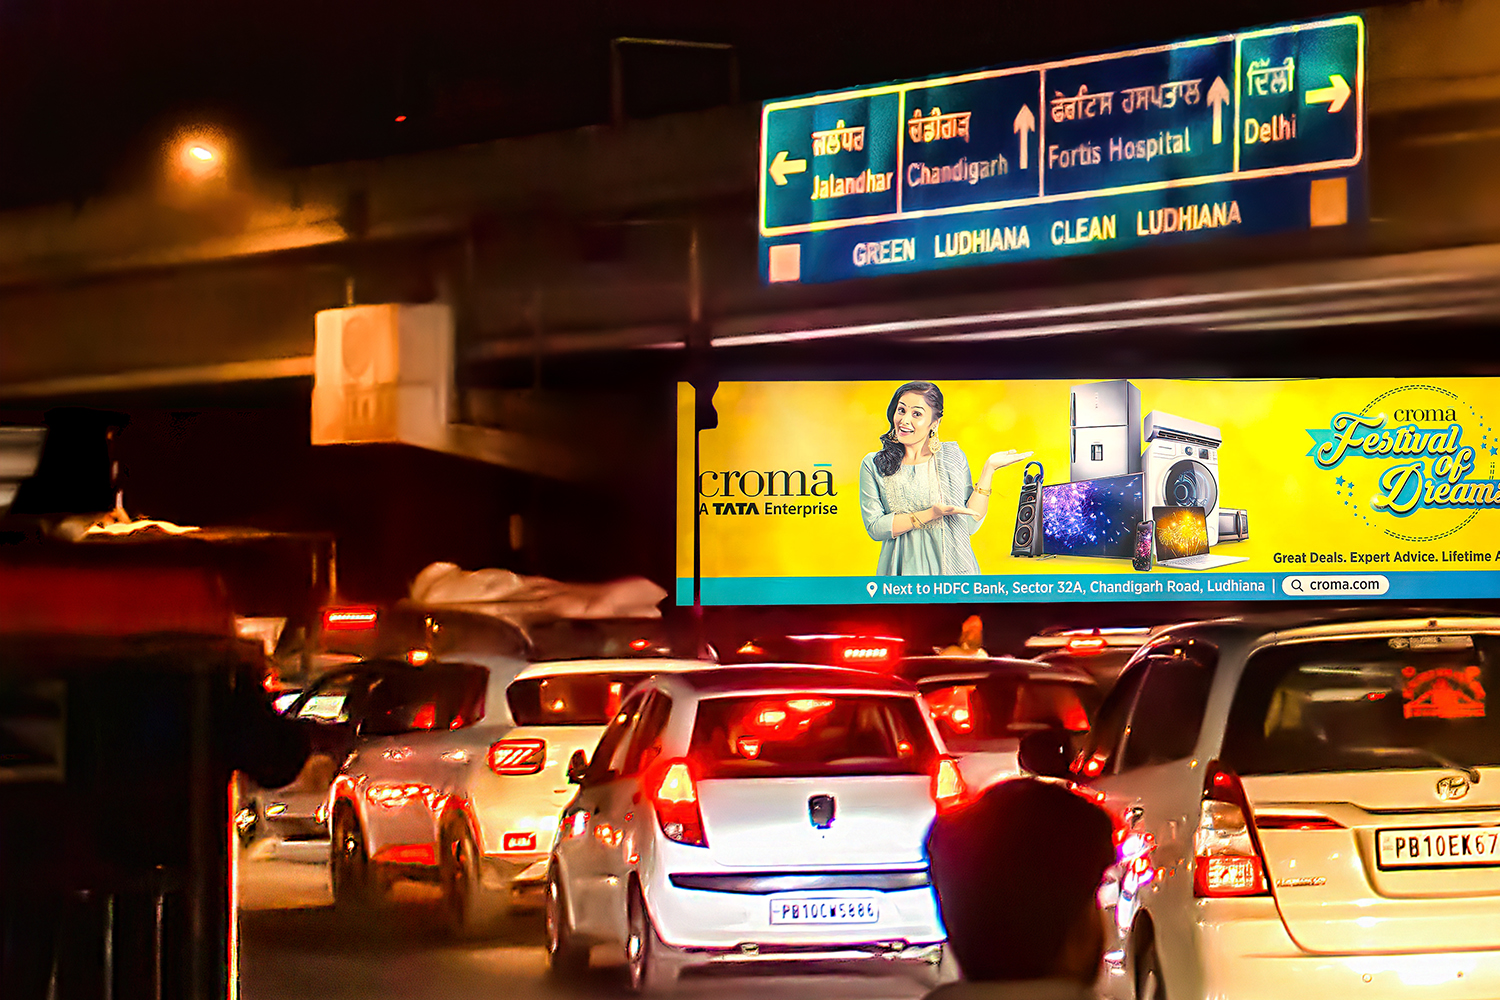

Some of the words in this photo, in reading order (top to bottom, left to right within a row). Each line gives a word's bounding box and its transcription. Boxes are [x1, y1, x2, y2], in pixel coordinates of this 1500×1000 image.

[1244, 113, 1297, 145] Delhi
[1048, 143, 1101, 170] Fortis
[1109, 126, 1191, 163] Hospital
[810, 168, 894, 201] Jalandhar
[907, 153, 1008, 188] Chandigarh
[852, 237, 916, 267] GREEN
[934, 225, 1030, 258] LUDHIANA
[1051, 214, 1117, 246] CLEAN
[1136, 200, 1243, 236] LUDHIANA
[1317, 413, 1459, 468] Festival
[1434, 447, 1472, 484] of
[699, 502, 709, 516] A
[713, 502, 760, 515] TATA
[764, 502, 838, 518] Enterprise
[1273, 551, 1307, 564] Great
[1309, 551, 1347, 564] Deals.
[1350, 551, 1390, 566] Expert
[1393, 550, 1439, 563] Advice.
[1441, 550, 1492, 562] Lifetime
[883, 583, 912, 595] Next
[916, 583, 931, 595] to
[933, 582, 969, 595] HDFC
[973, 582, 1009, 597] Bank,
[1012, 581, 1054, 594] Sector
[1057, 581, 1086, 595] 32A,
[1089, 580, 1164, 594] Chandigarh
[1167, 580, 1203, 594] Road,
[1207, 579, 1265, 592] Ludhiana
[1310, 578, 1380, 591] croma.com
